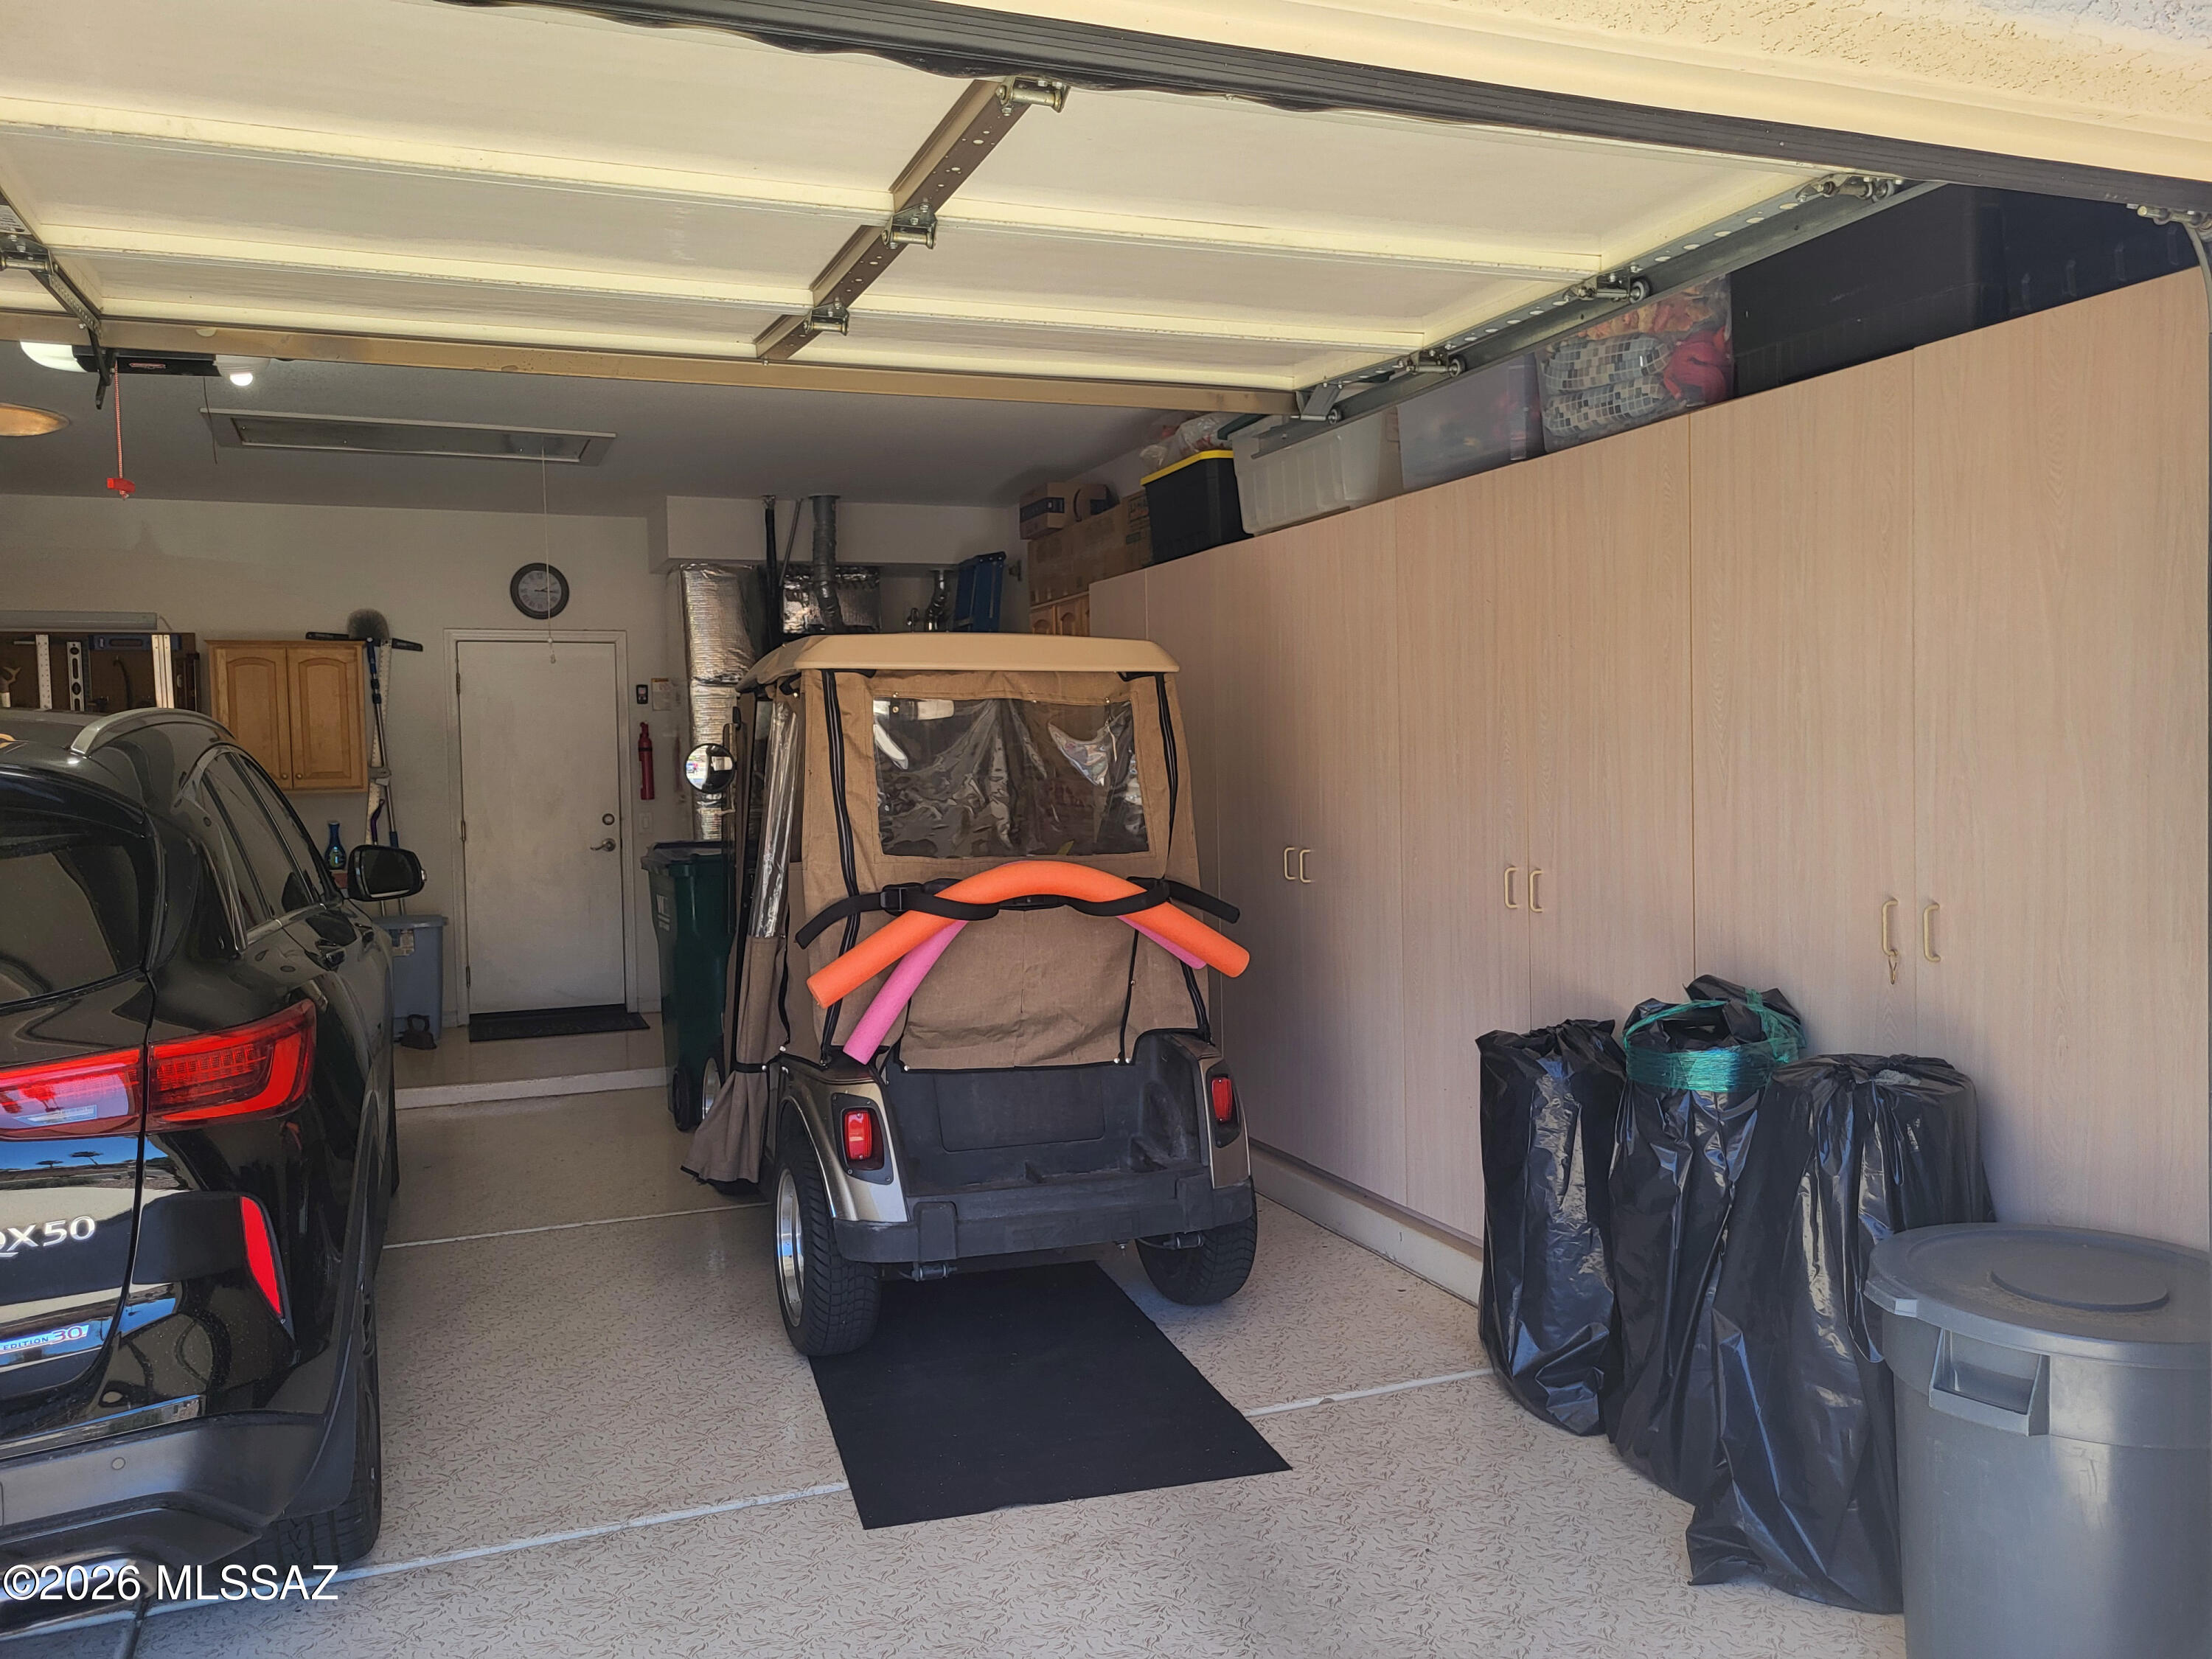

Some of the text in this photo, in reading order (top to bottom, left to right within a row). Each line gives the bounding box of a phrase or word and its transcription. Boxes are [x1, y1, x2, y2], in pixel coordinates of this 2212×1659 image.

[0, 1215, 95, 1257] X50
[3, 1326, 84, 1351] EDITION 30
